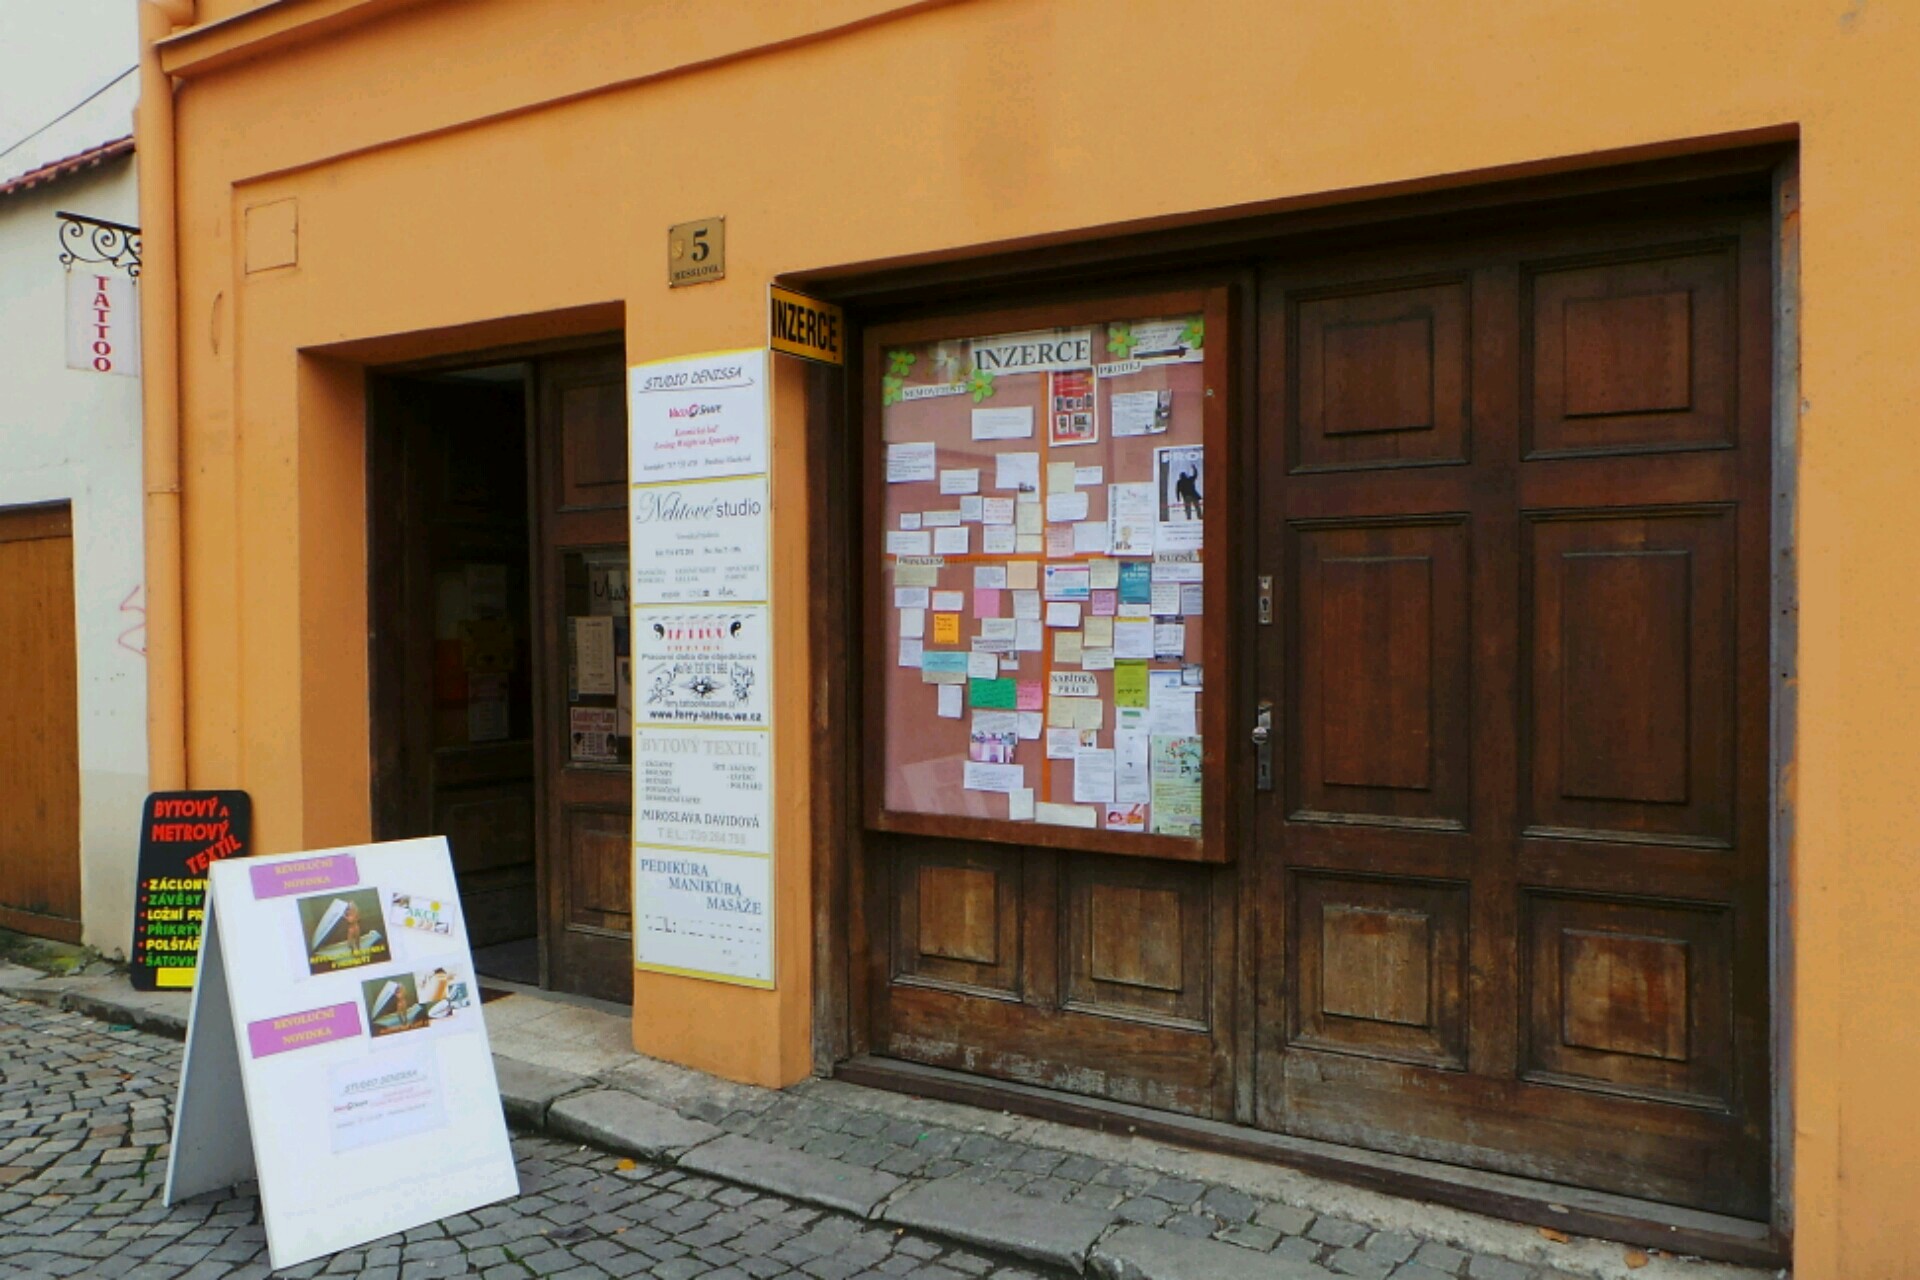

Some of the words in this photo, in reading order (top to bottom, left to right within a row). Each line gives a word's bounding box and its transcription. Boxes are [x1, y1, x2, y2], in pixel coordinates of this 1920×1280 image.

[691, 228, 710, 261] 5
[93, 275, 112, 373] TATTOO
[771, 298, 838, 352] INZERCE
[974, 339, 1089, 371] INZERCE
[644, 372, 688, 390] STUDIO
[716, 498, 761, 518] studio
[641, 735, 701, 754] BYTOVÝ
[154, 797, 218, 818] BYTOVÝ
[219, 806, 230, 818] A
[641, 809, 702, 825] MIROSLAVA
[704, 812, 760, 829] DAVIDOVÁ
[152, 819, 230, 842] METROVÝ
[185, 834, 243, 875] TEXTIL
[641, 857, 708, 878] PEDIKÚRA
[149, 876, 210, 891] ZÁCLONY
[669, 875, 742, 897] MANIKÚRA
[149, 891, 202, 906] ZÁVĚSY
[707, 894, 761, 916] MASÁŽE
[148, 906, 184, 920] LOŽNÍ
[145, 952, 196, 967] ŠATOVK
